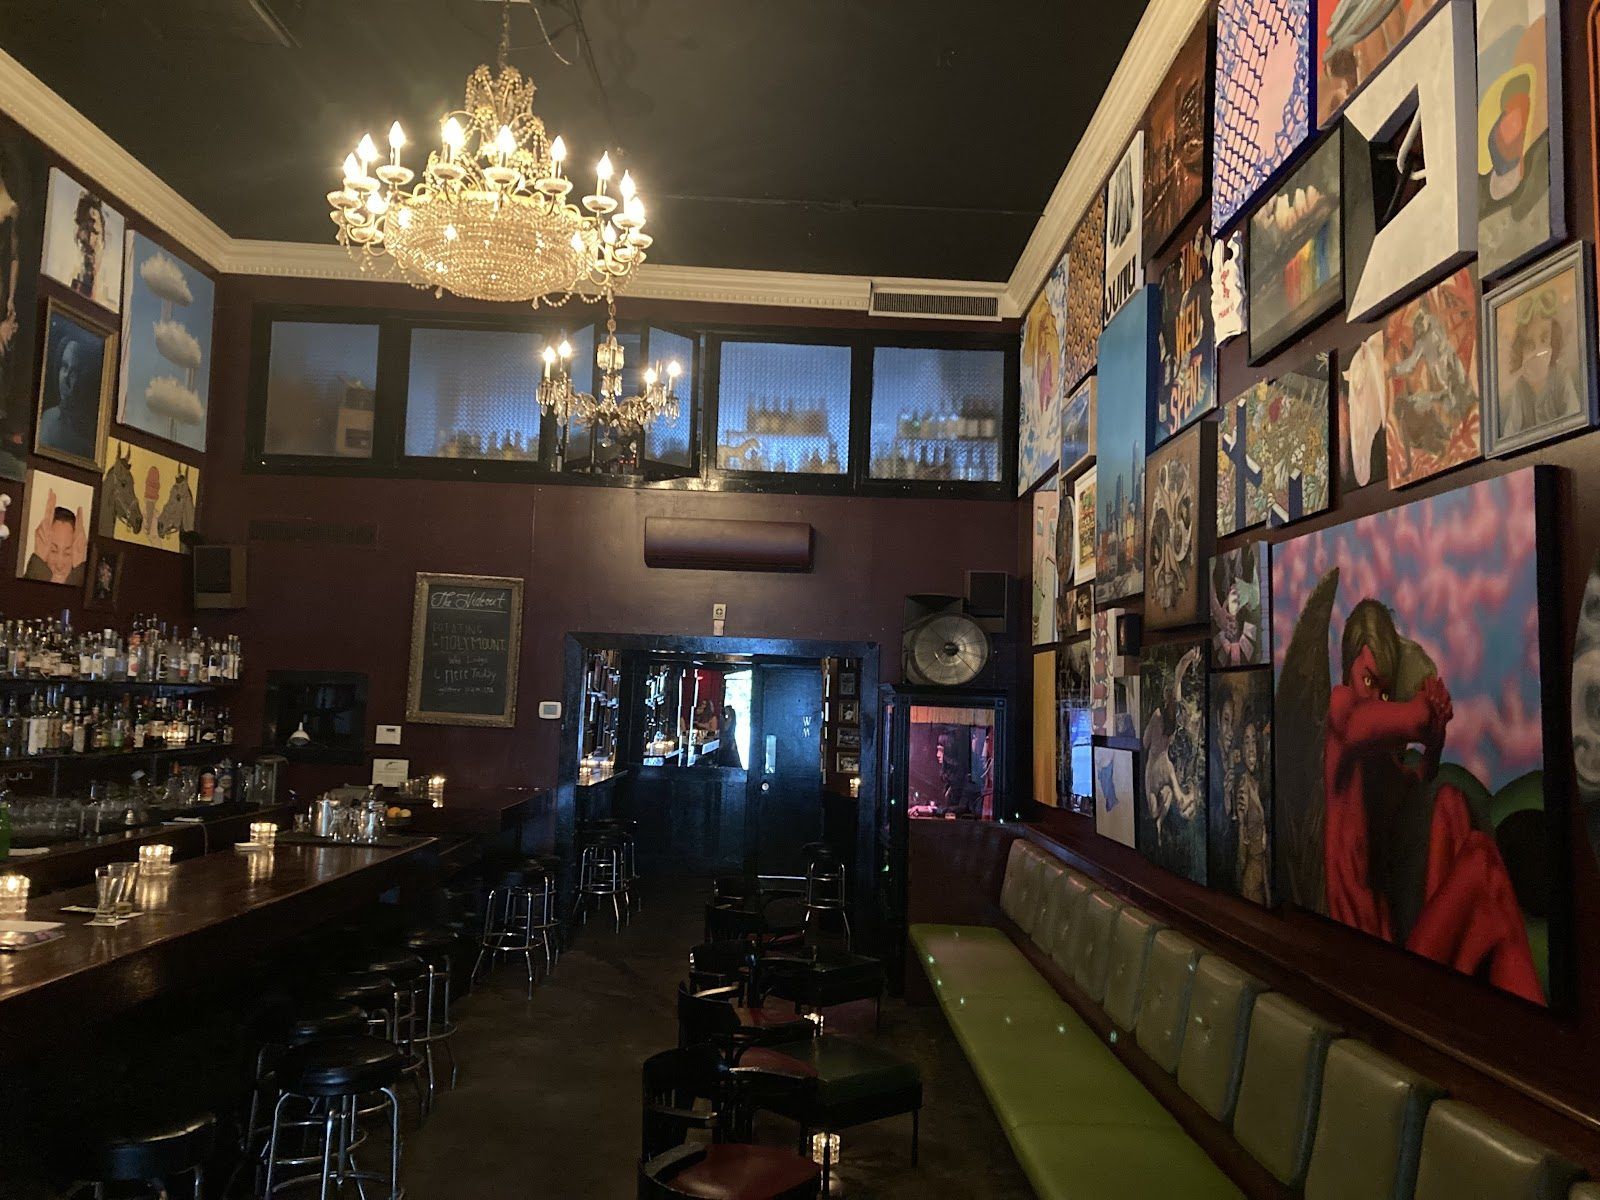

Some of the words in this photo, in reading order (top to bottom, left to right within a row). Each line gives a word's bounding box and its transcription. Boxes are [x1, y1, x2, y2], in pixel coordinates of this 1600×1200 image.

[1174, 294, 1204, 360] WELL
[1169, 352, 1204, 438] SPENT
[430, 590, 456, 608] The
[455, 590, 506, 609] Hideout
